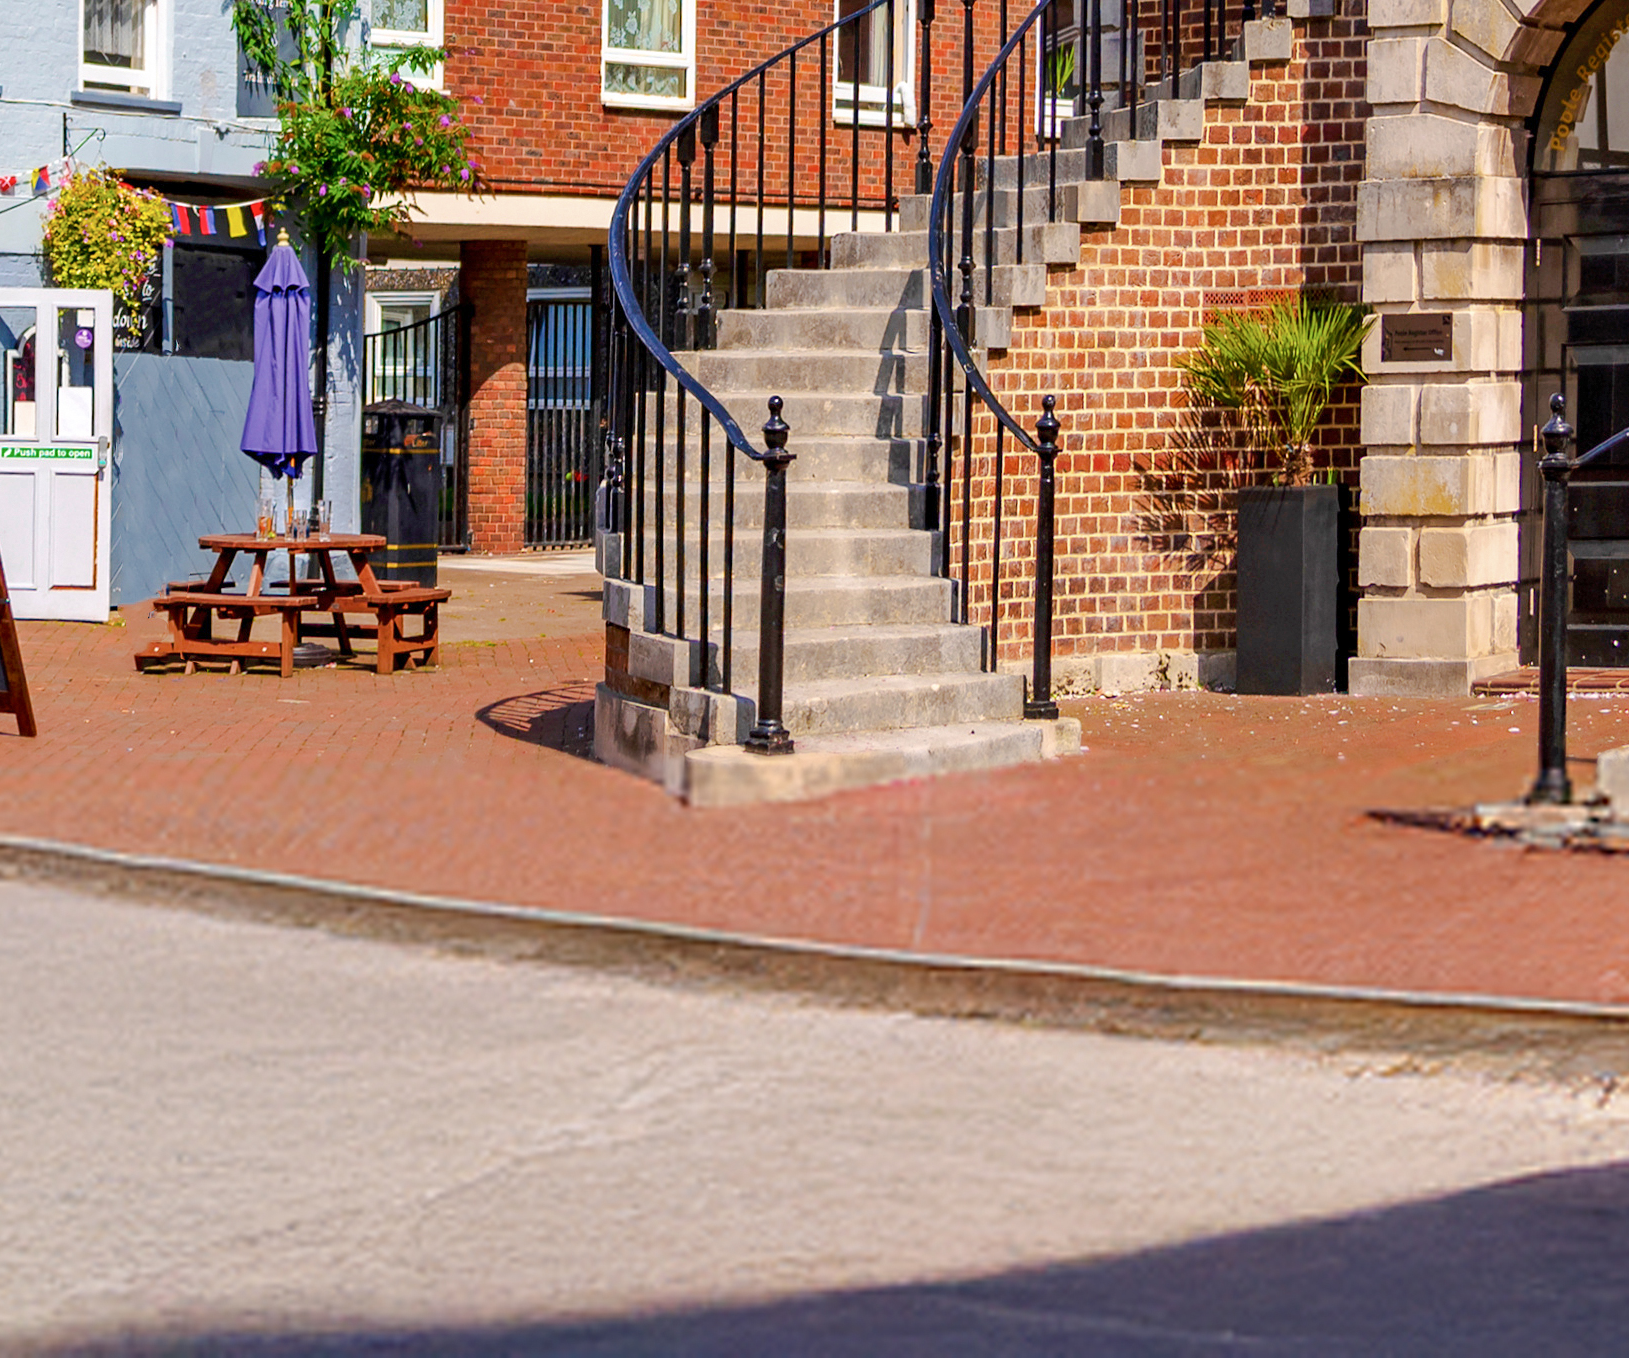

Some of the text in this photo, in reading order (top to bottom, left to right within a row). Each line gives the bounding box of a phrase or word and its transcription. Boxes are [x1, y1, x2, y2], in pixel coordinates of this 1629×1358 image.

[1551, 87, 1582, 151] Poole
[14, 448, 91, 459] Push pad to open
